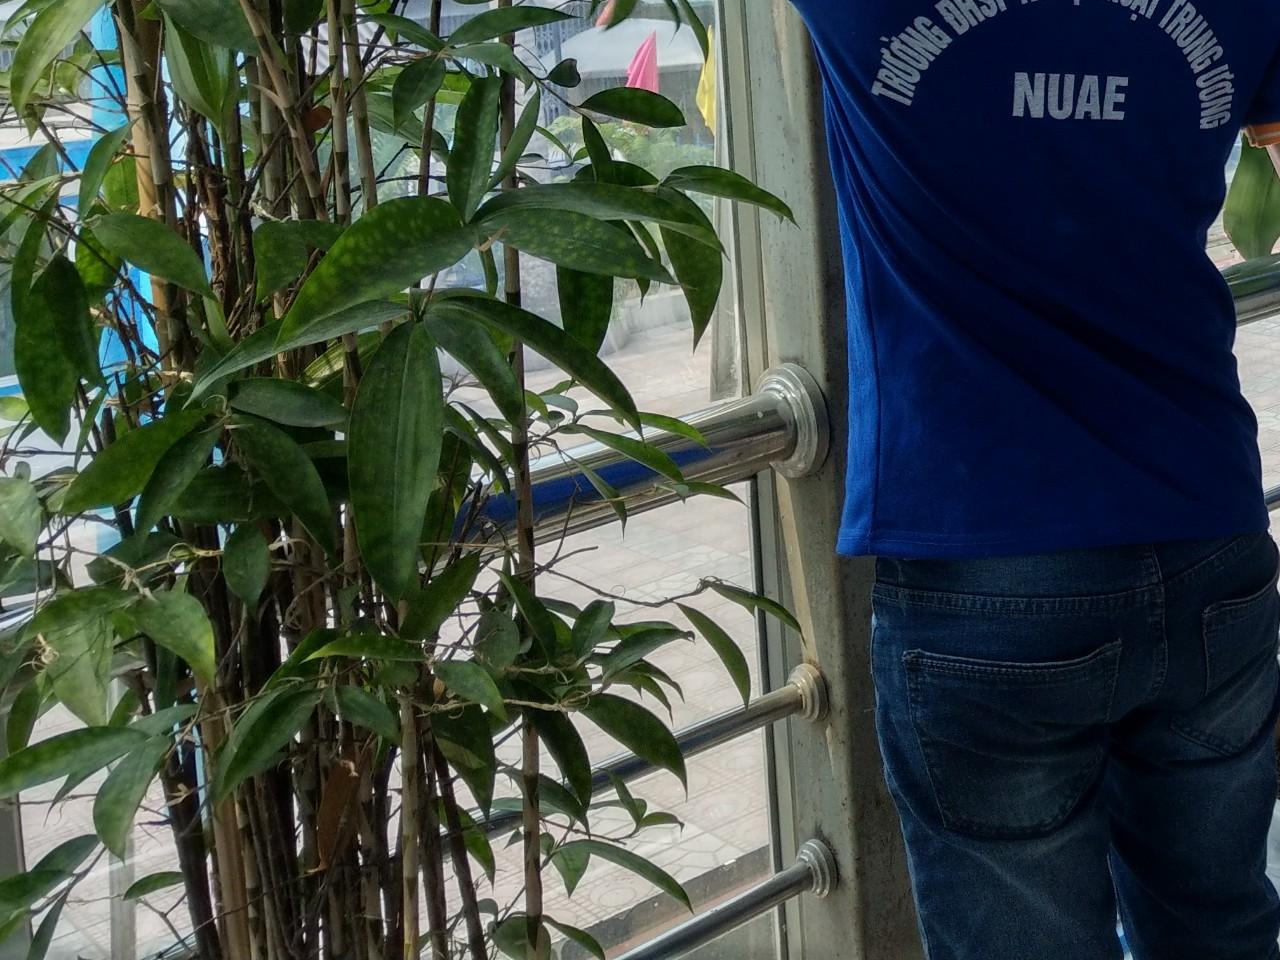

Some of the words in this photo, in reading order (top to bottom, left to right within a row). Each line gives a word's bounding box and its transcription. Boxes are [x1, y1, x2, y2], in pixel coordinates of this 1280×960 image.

[871, 15, 953, 107] TRƯỜNG
[1195, 63, 1236, 130] ƯƠNG
[1012, 72, 1129, 120] NUAE
